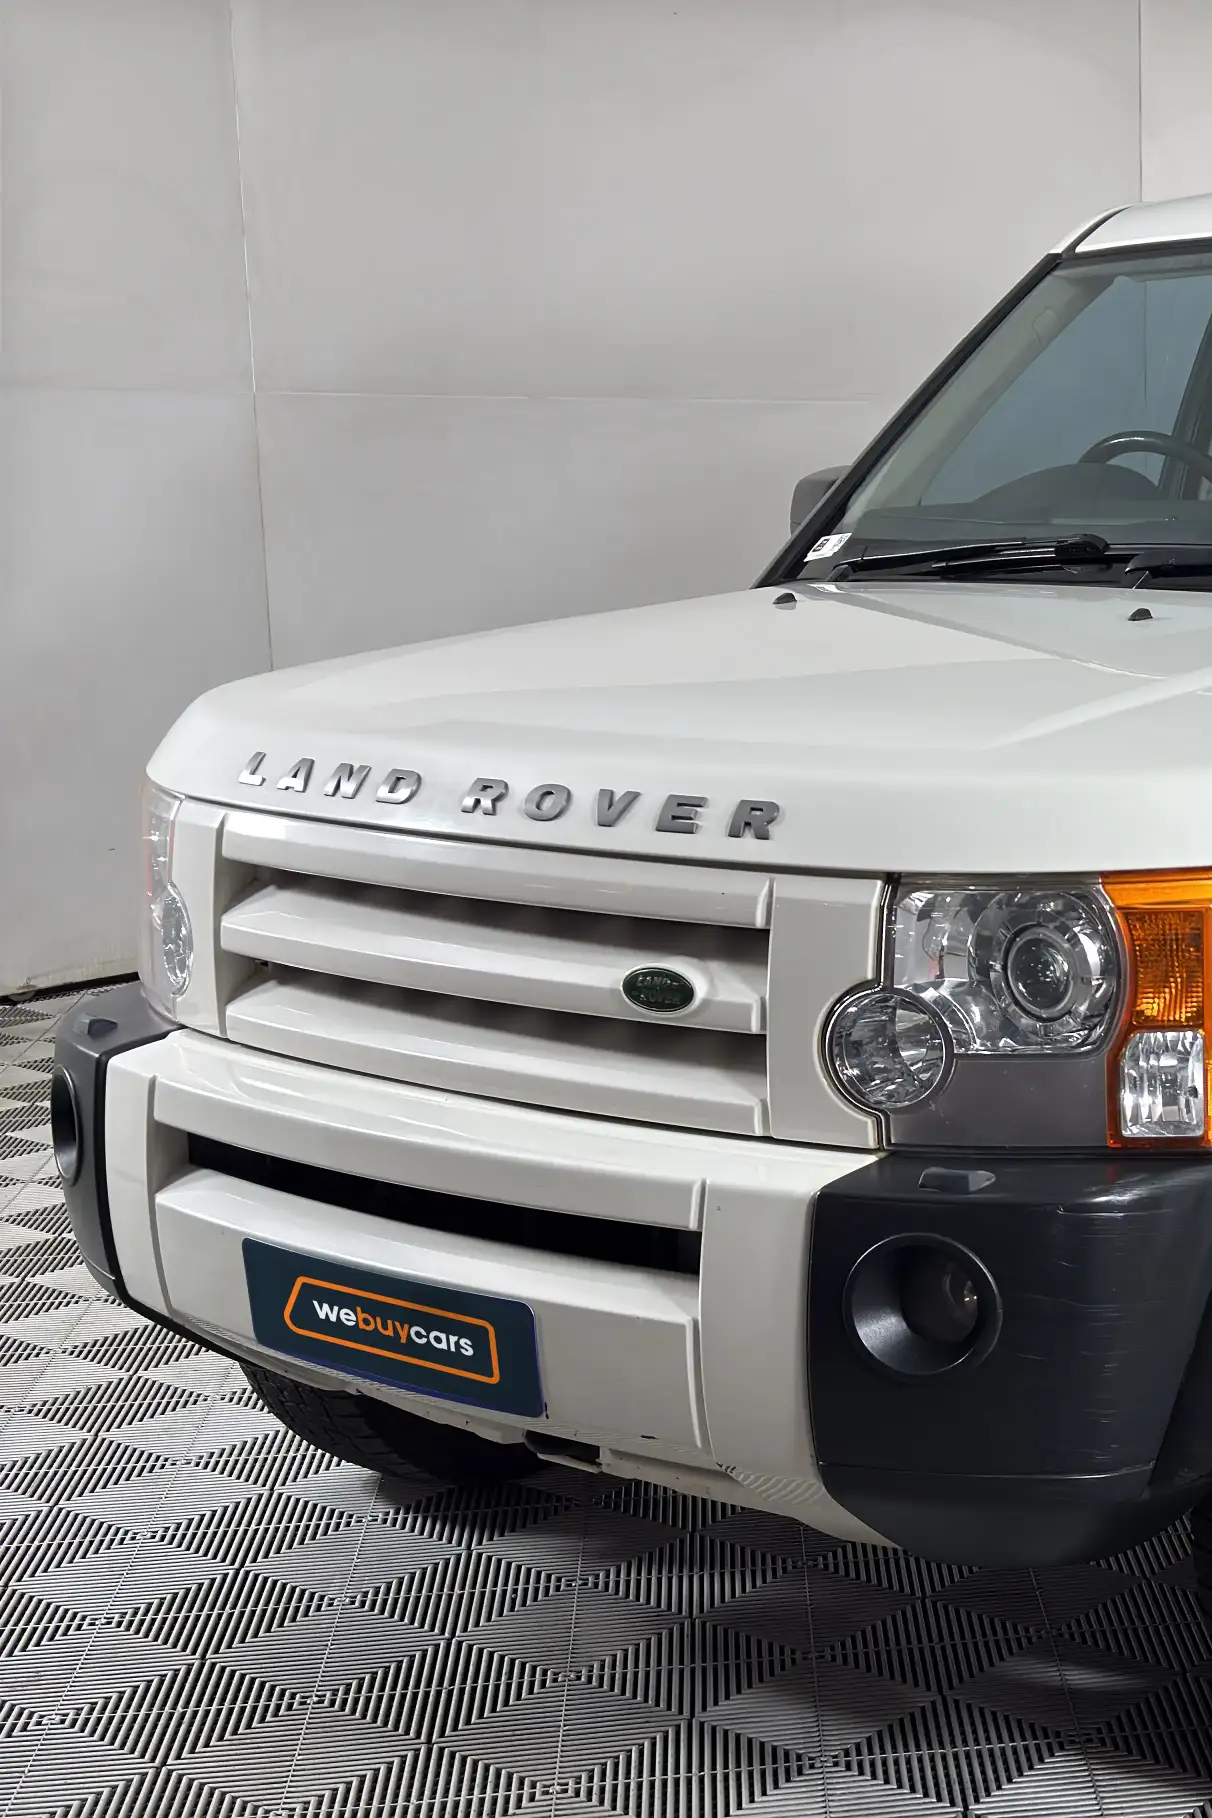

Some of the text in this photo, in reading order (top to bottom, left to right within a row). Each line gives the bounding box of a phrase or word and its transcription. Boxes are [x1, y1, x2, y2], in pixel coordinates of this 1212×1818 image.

[238, 751, 782, 840] LAND ROVER
[313, 1300, 474, 1356] webuycars
